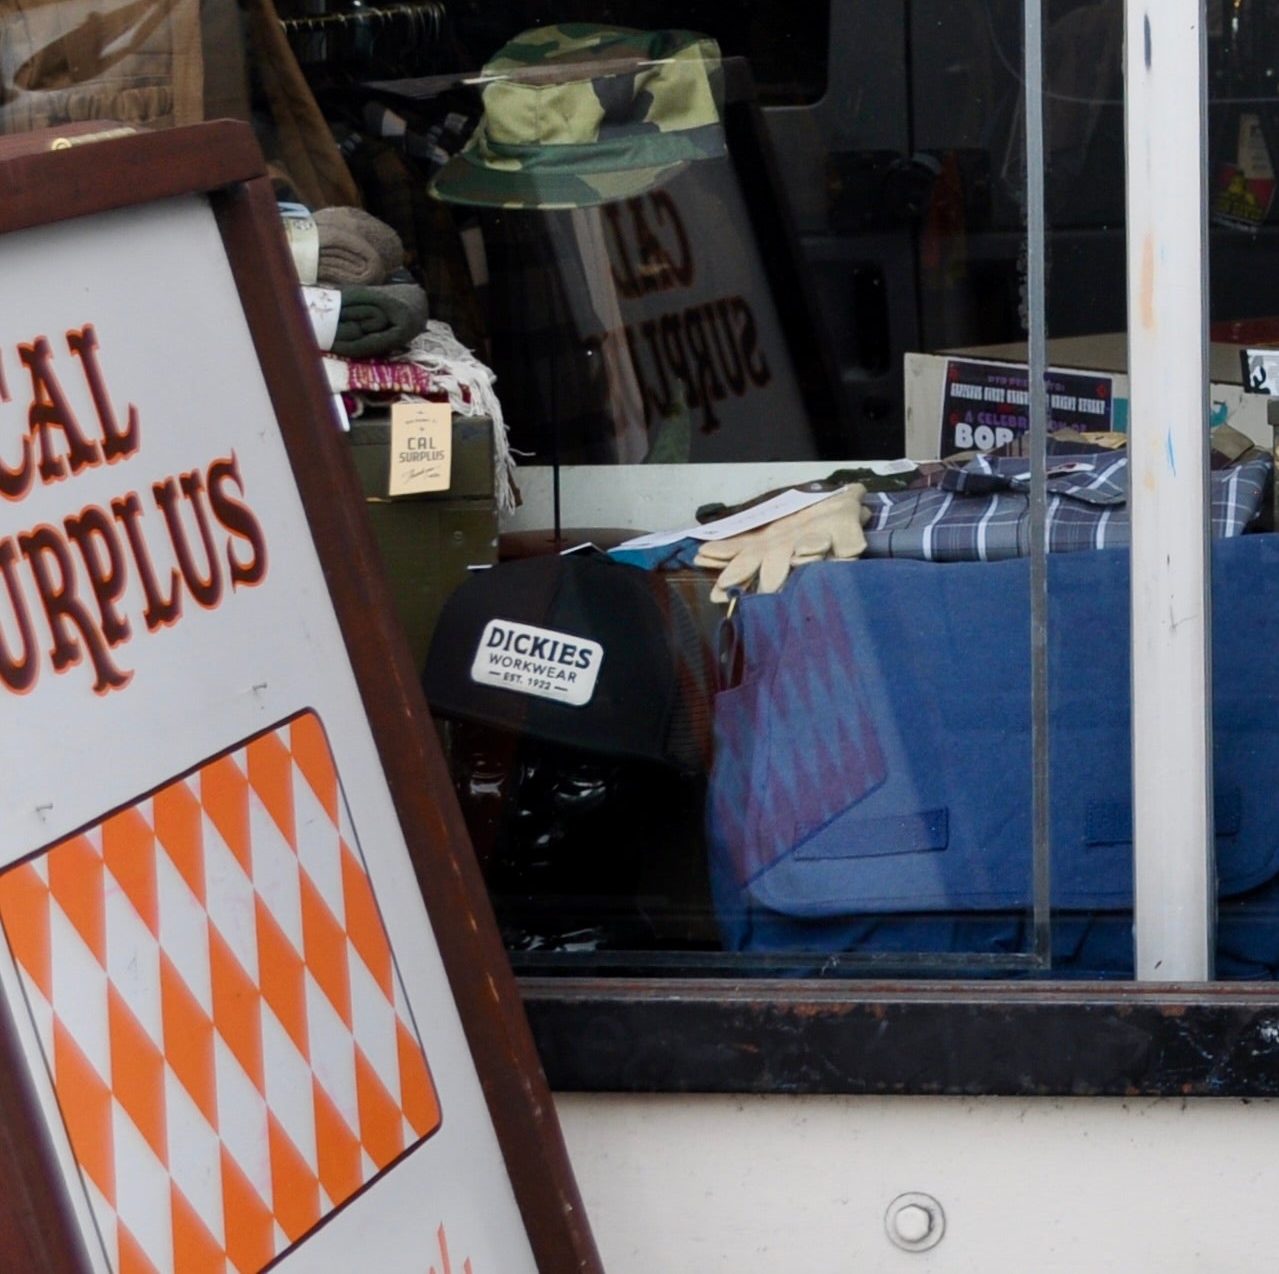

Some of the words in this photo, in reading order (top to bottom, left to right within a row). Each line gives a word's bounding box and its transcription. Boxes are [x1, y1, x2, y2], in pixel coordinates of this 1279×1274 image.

[407, 437, 437, 451] CAL
[399, 450, 445, 464] SURPLUS
[0, 447, 269, 696] URPLUS
[486, 627, 593, 670] DICKIES
[489, 653, 577, 684] WORKWEAR
[503, 672, 523, 685] EST.
[527, 677, 552, 691] 1922
